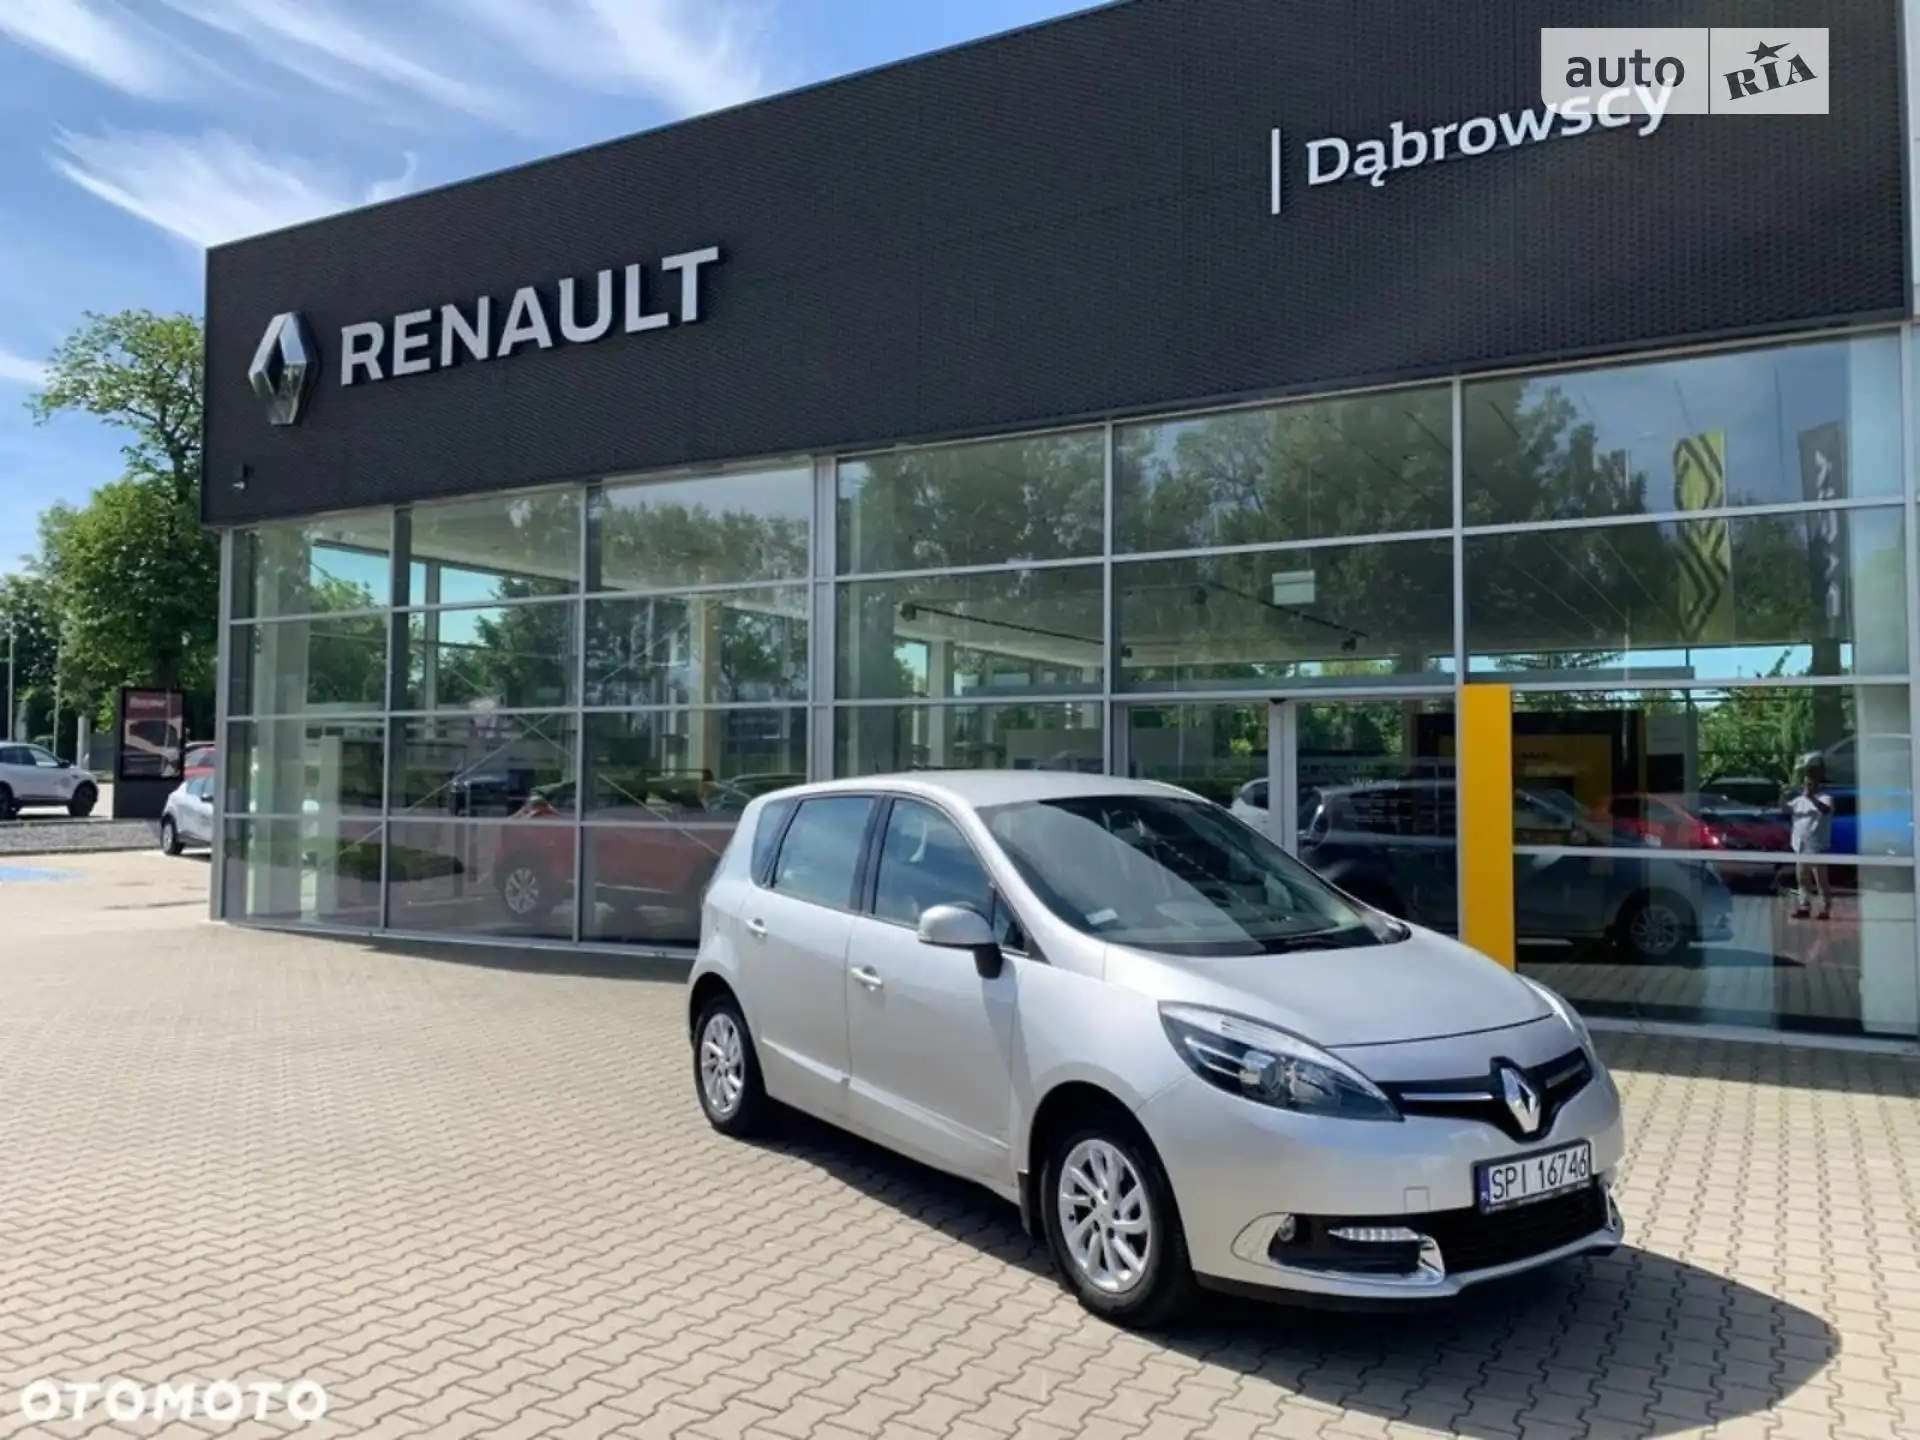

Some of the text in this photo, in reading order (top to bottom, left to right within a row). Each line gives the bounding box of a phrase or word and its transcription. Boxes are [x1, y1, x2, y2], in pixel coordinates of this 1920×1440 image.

[1305, 77, 1675, 187] Dąbrowscy
[340, 245, 720, 388] RENAULT
[1491, 1148, 1588, 1199] SPI 16746
